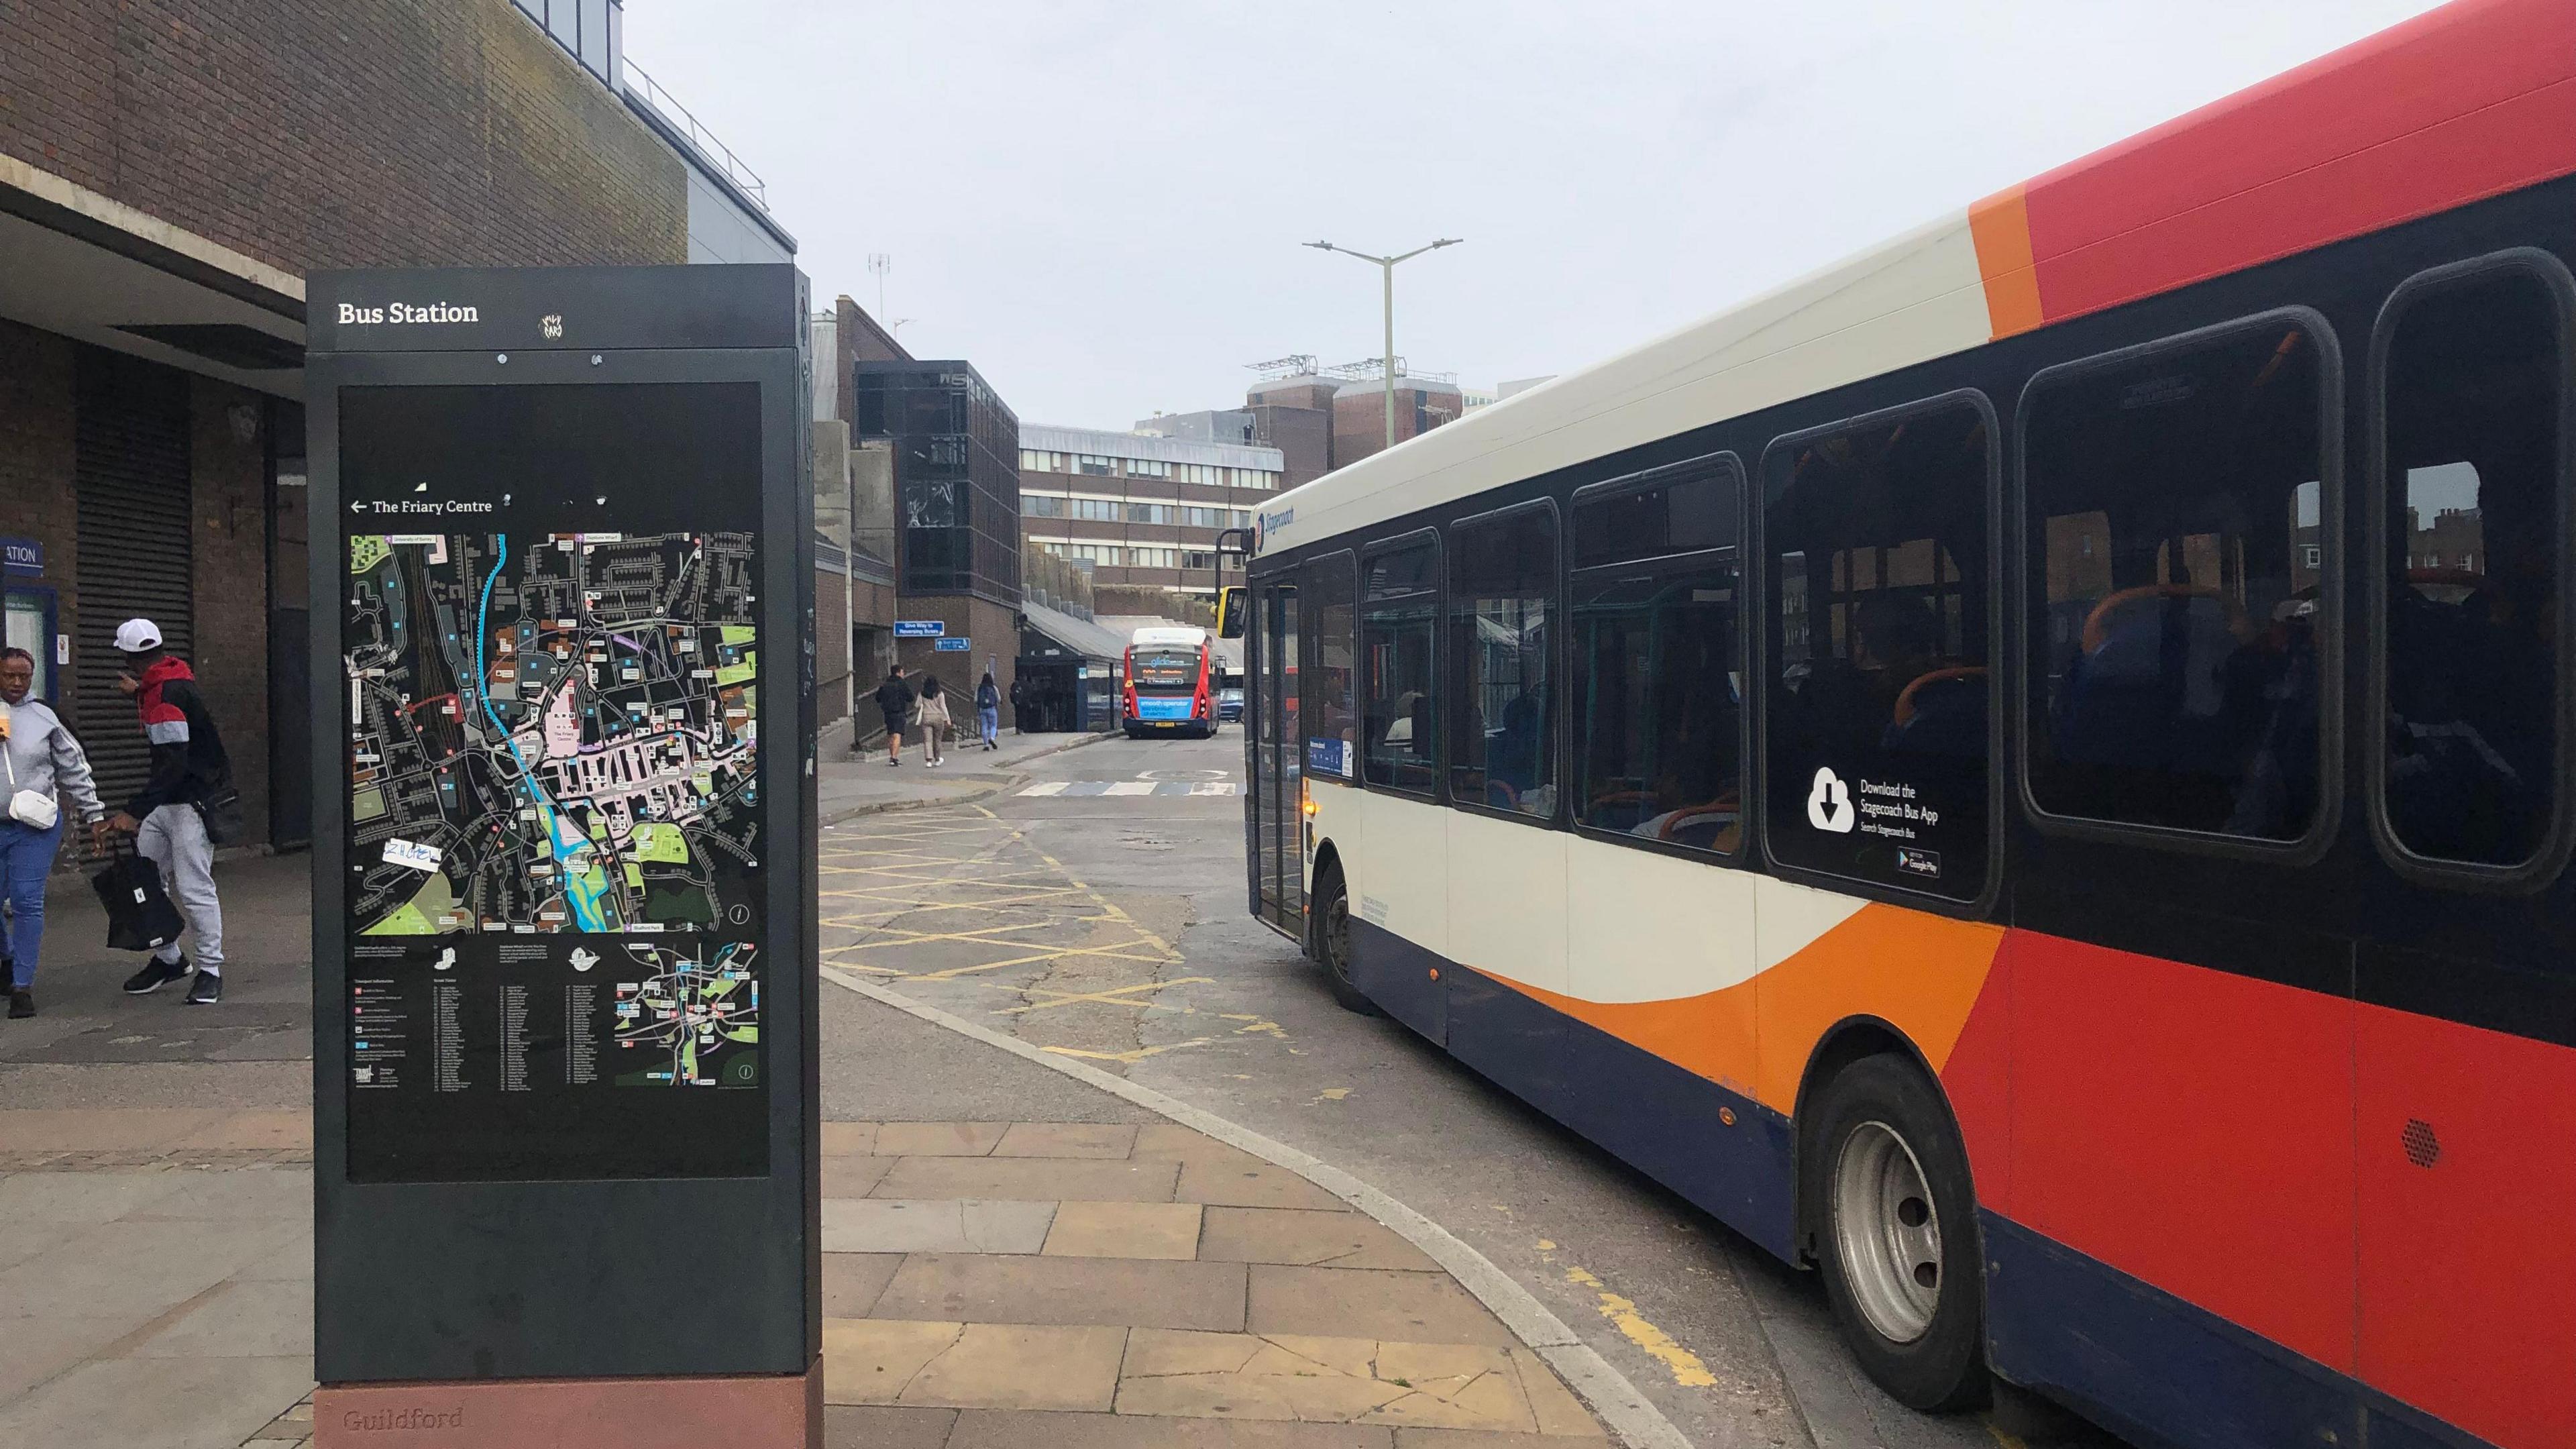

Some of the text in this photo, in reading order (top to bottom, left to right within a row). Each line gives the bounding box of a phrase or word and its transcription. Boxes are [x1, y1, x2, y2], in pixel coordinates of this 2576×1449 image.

[338, 302, 478, 324] Bus Station
[372, 500, 492, 515] The Friary Centre
[1265, 504, 1294, 535] Stagecoach
[1860, 779, 1916, 799] Download the
[1860, 798, 1938, 826] Stagecoach Bus App
[1860, 821, 1915, 839] Search Stagecoach Bus
[1909, 858, 1937, 874] Google Play
[343, 1407, 464, 1431] Guildford
